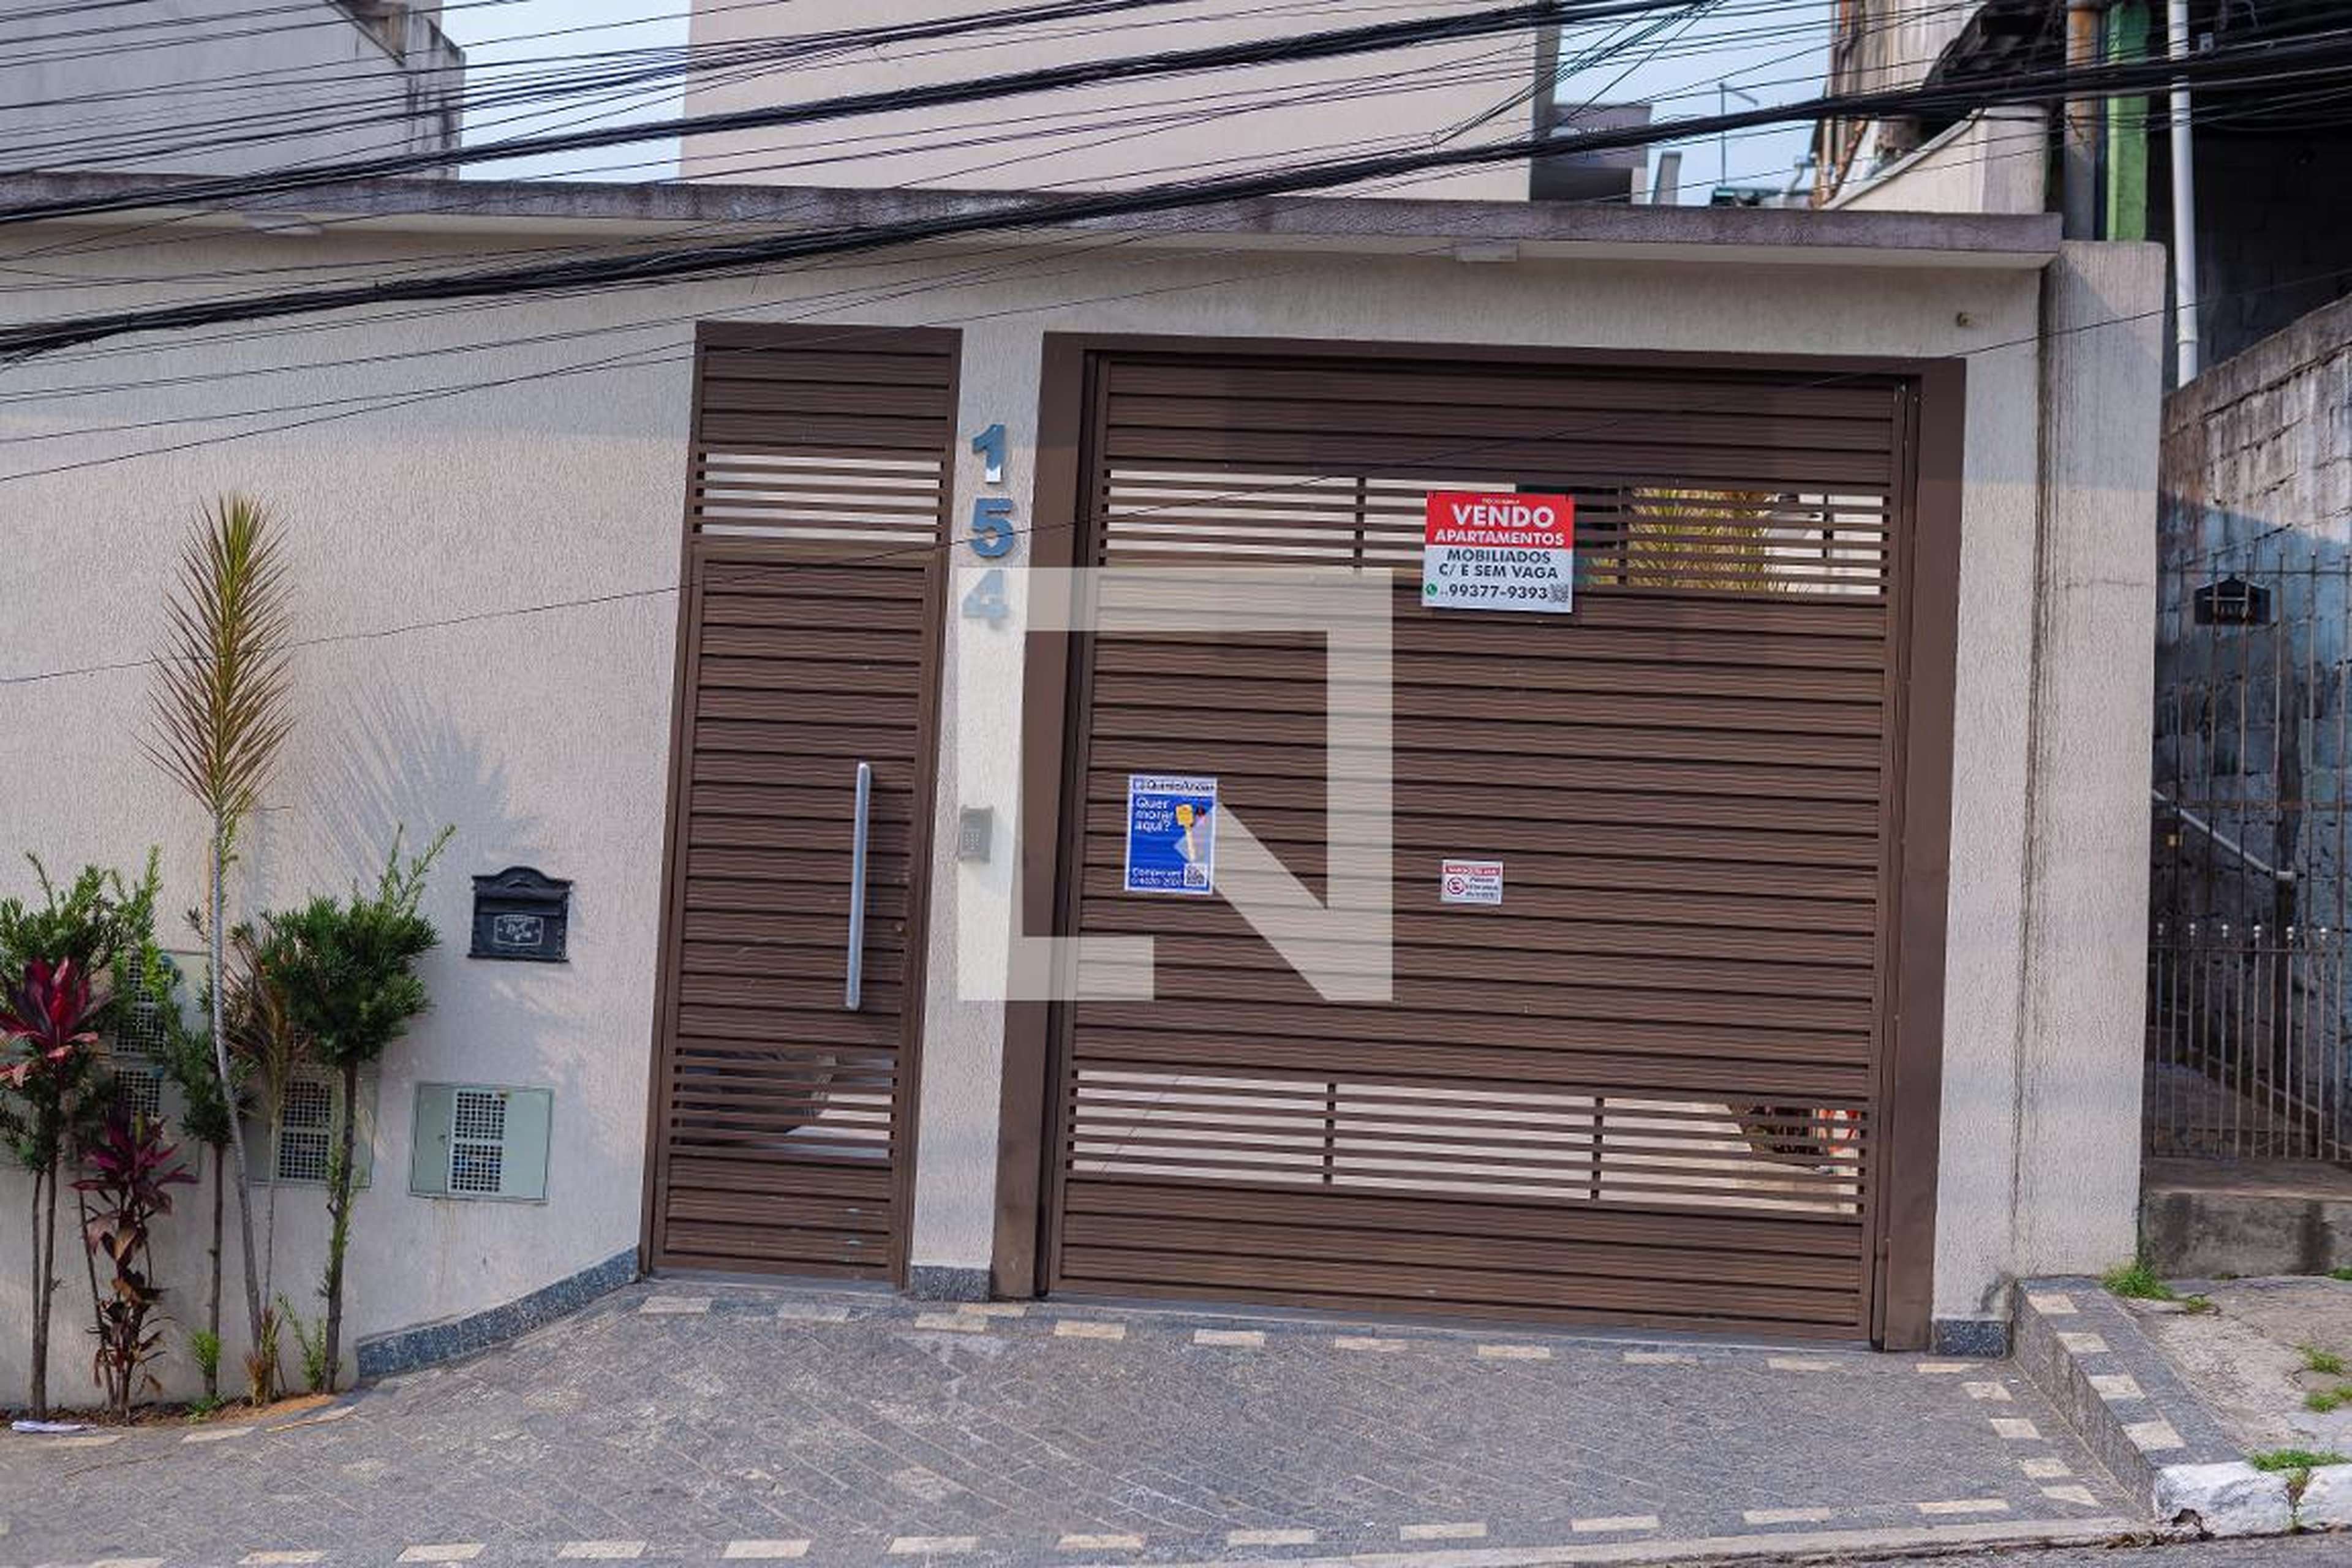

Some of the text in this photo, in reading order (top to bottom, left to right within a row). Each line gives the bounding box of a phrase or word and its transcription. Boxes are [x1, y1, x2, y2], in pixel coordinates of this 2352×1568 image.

[1451, 503, 1555, 528] VENDO
[1434, 529, 1565, 546] APARTAMENTOS
[1447, 549, 1551, 564] MOBILIADOS
[1439, 563, 1558, 579] C/ E SEM VAGA
[1449, 583, 1548, 599] 99377-9393
[1136, 797, 1170, 809] Quer
